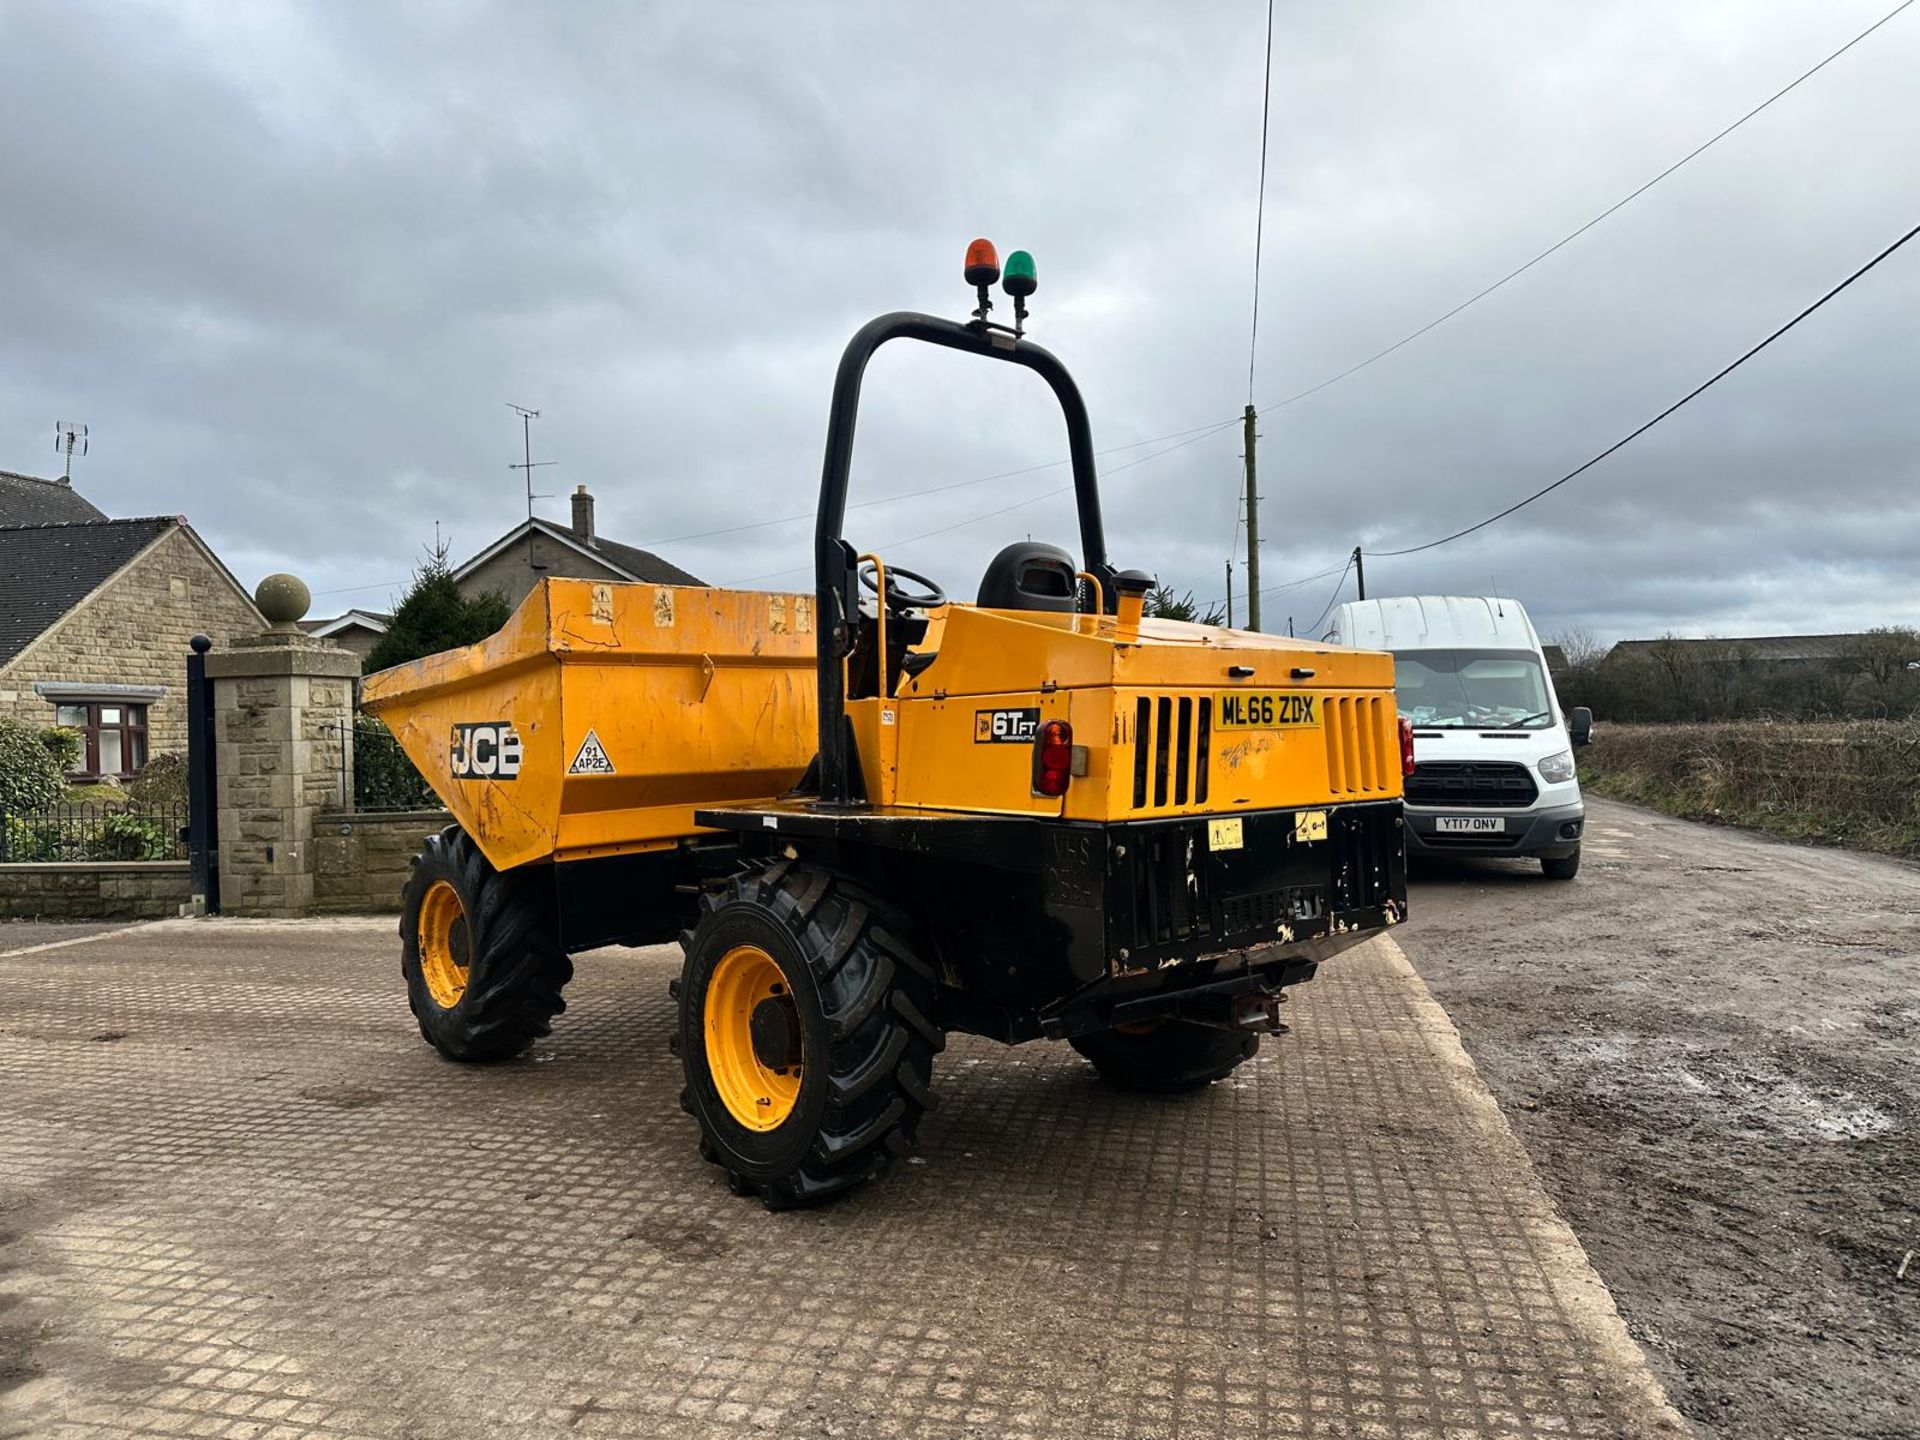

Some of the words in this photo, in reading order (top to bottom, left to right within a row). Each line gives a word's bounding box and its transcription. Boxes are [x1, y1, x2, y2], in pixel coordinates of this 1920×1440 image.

[1222, 696, 1273, 725] ML66
[1279, 695, 1314, 723] ZDX
[452, 726, 523, 775] JCB
[585, 746, 598, 757] 91
[579, 757, 605, 769] AP2E
[1442, 818, 1470, 830] YT17
[1473, 818, 1498, 830] ONV
